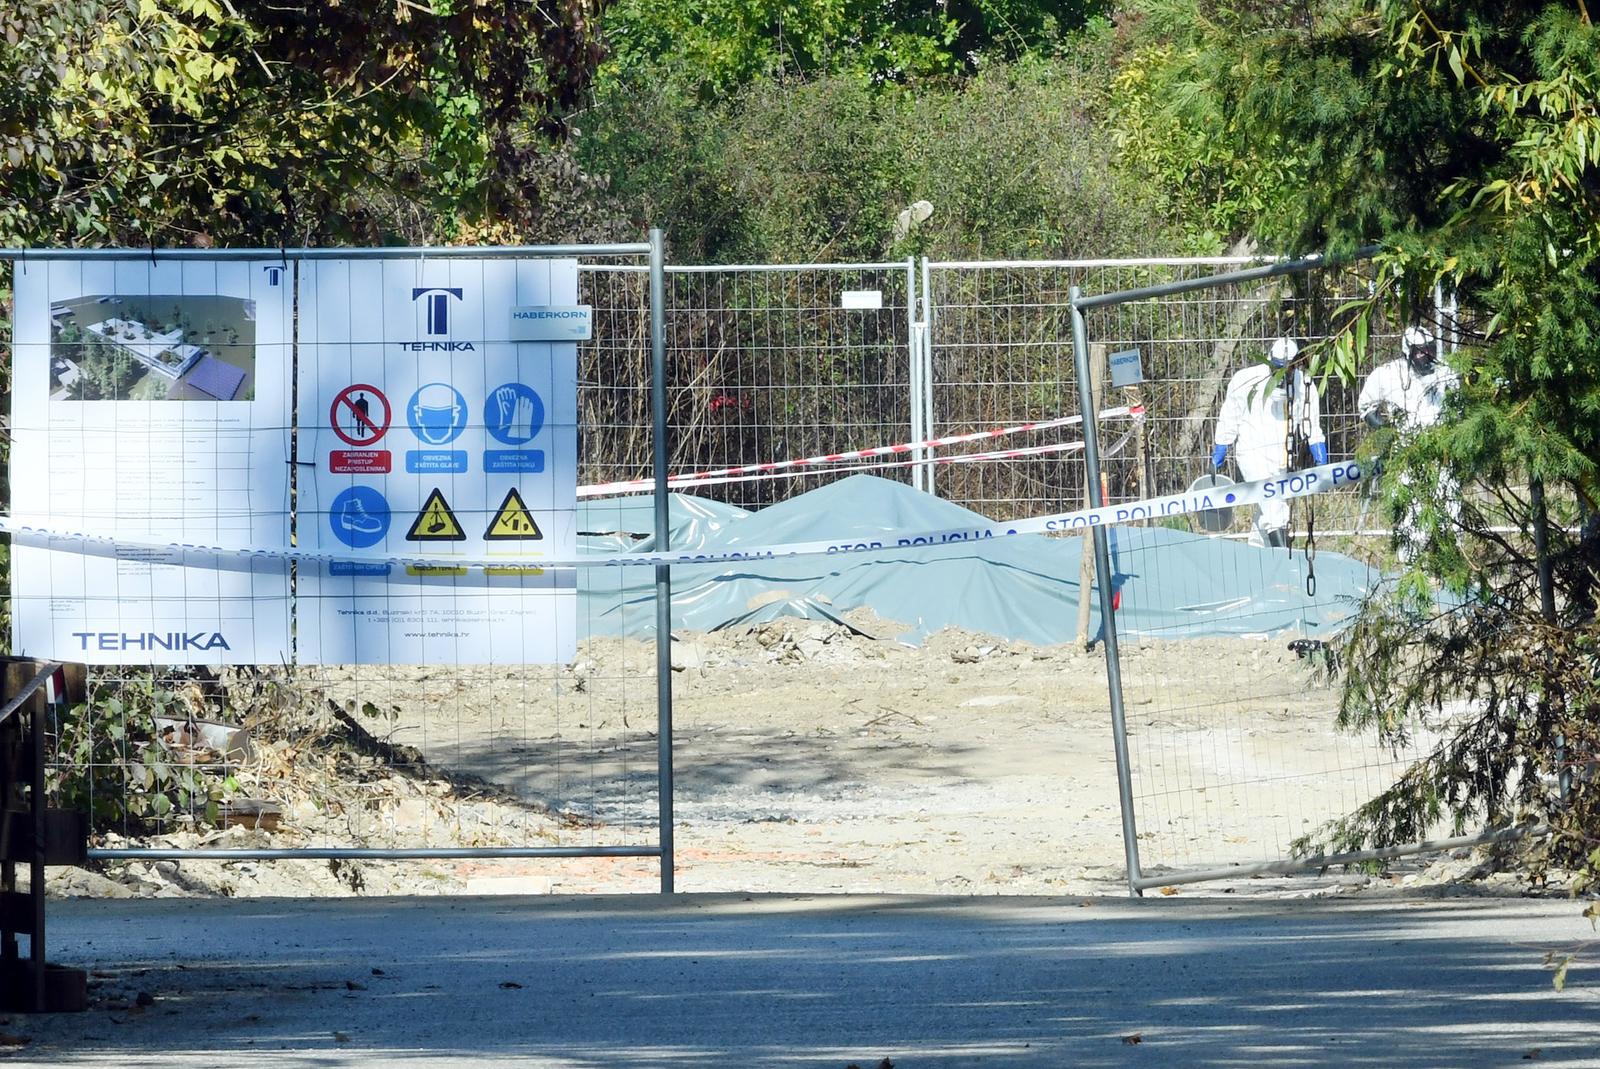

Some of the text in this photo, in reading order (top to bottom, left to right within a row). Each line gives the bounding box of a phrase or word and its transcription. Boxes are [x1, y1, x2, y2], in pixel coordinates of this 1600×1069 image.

[513, 311, 588, 320] HABERKORN
[401, 342, 475, 352] TEHNIKA
[1263, 472, 1318, 498] STOP
[72, 632, 231, 651] TEHNIKA
